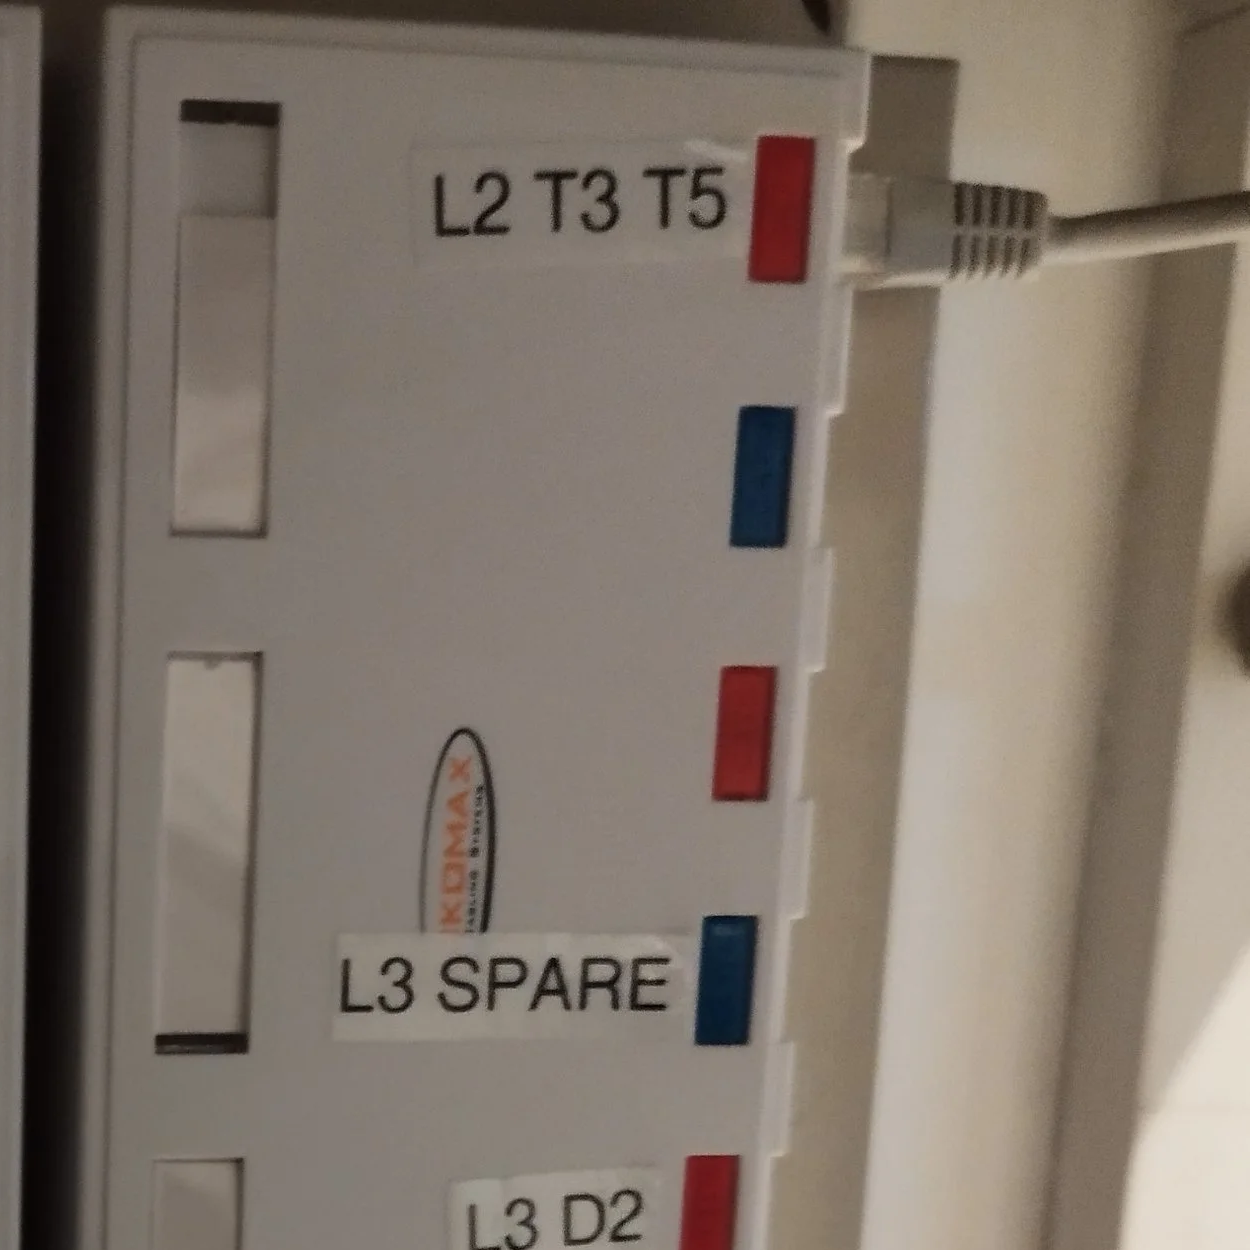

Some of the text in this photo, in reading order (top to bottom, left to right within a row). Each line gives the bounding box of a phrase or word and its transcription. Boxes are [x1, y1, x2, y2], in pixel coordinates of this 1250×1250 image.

[434, 166, 727, 238] L2 T3 T5
[340, 956, 670, 1014] L3 SPARE
[563, 1188, 643, 1246] D2
